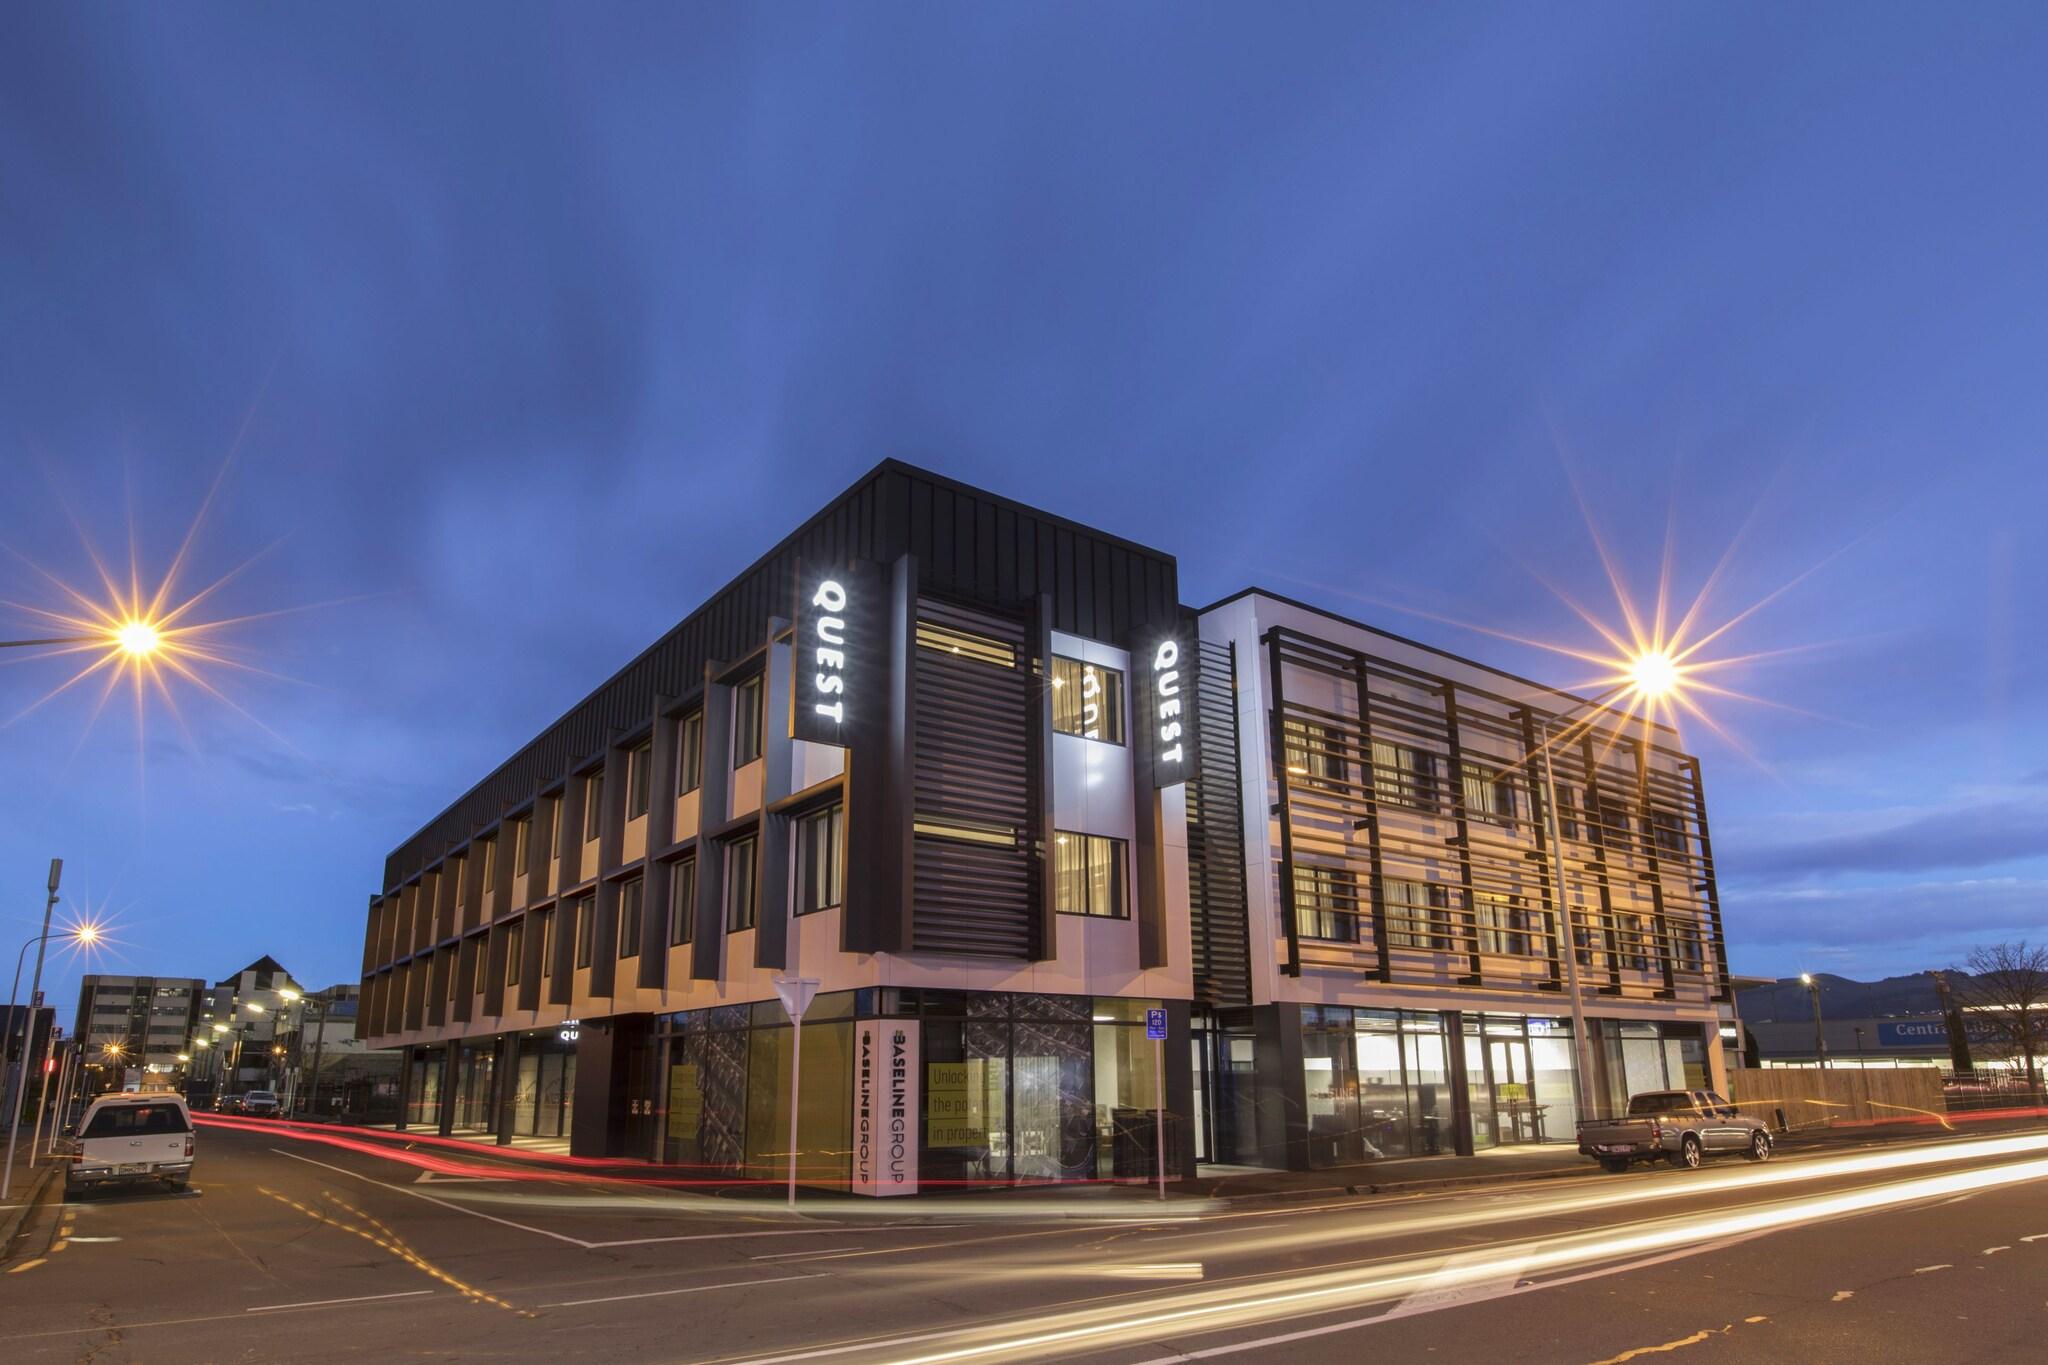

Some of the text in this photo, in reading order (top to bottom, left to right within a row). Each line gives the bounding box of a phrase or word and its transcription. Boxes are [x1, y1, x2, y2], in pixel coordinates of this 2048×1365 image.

[812, 580, 847, 724] QUEST
[1154, 640, 1183, 764] QUEST
[1896, 1022, 1949, 1036] Centra
[891, 1030, 906, 1184] BASELINEGROUP
[933, 1125, 944, 1141] in
[934, 1096, 952, 1112] the
